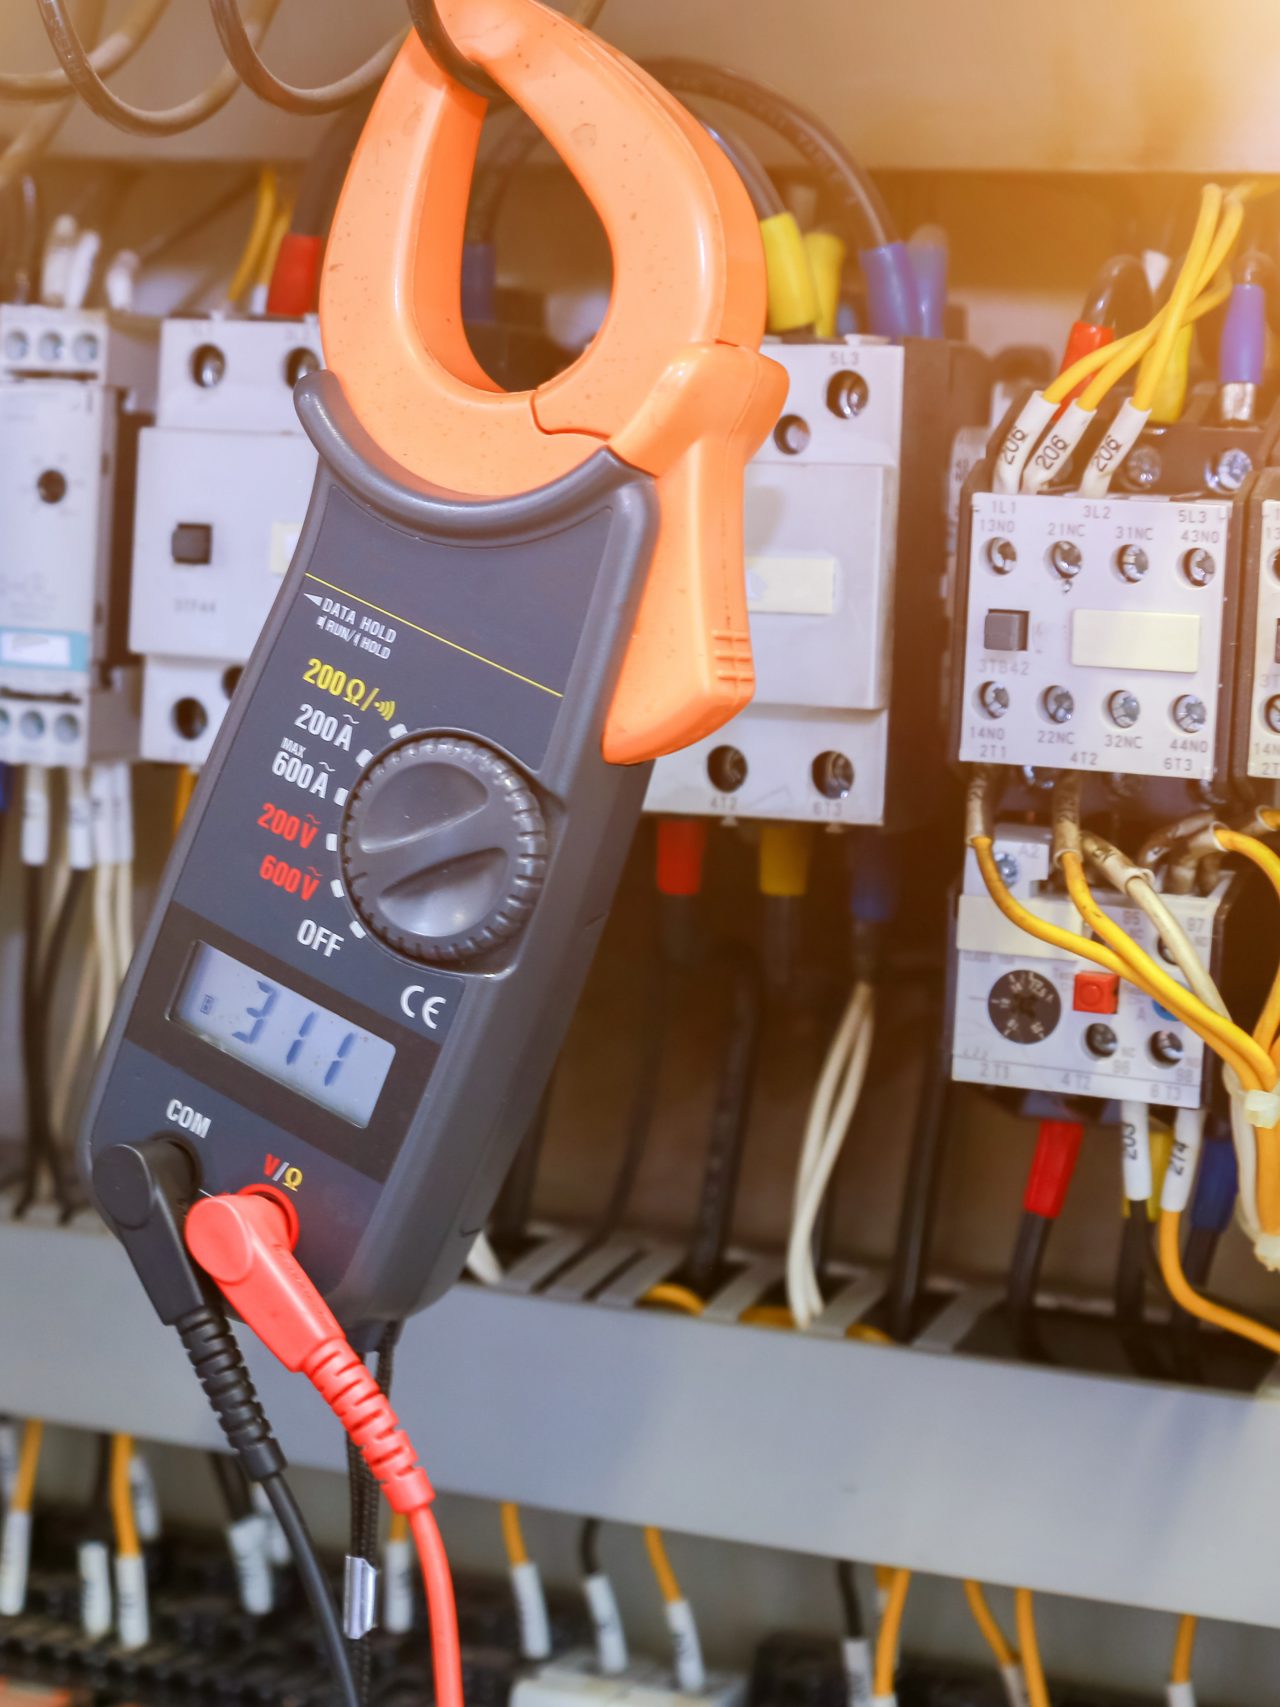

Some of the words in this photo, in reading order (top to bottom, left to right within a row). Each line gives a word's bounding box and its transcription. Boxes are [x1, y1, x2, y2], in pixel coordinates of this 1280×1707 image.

[1035, 434, 1070, 470] 206
[1094, 434, 1122, 472] 206
[1083, 504, 1111, 520] 3L2
[1178, 509, 1207, 523] 5L3
[1047, 522, 1085, 537] 21NC
[1115, 526, 1153, 541] 31NC
[1181, 529, 1220, 544] 43NO
[321, 597, 357, 625] DATA
[359, 616, 397, 644] HOLD
[359, 636, 391, 660] HOLD
[280, 737, 307, 758] MAX
[980, 744, 1007, 758] 2T1
[1070, 751, 1098, 766] 4T2
[1163, 757, 1193, 772] 6T3
[1037, 730, 1075, 745] 22NC
[1104, 733, 1143, 749] 32NC
[1169, 738, 1208, 753] 44NO
[297, 919, 345, 958] OFF
[401, 985, 447, 1030] CE
[232, 980, 357, 1087] 311
[166, 1098, 212, 1139] COM
